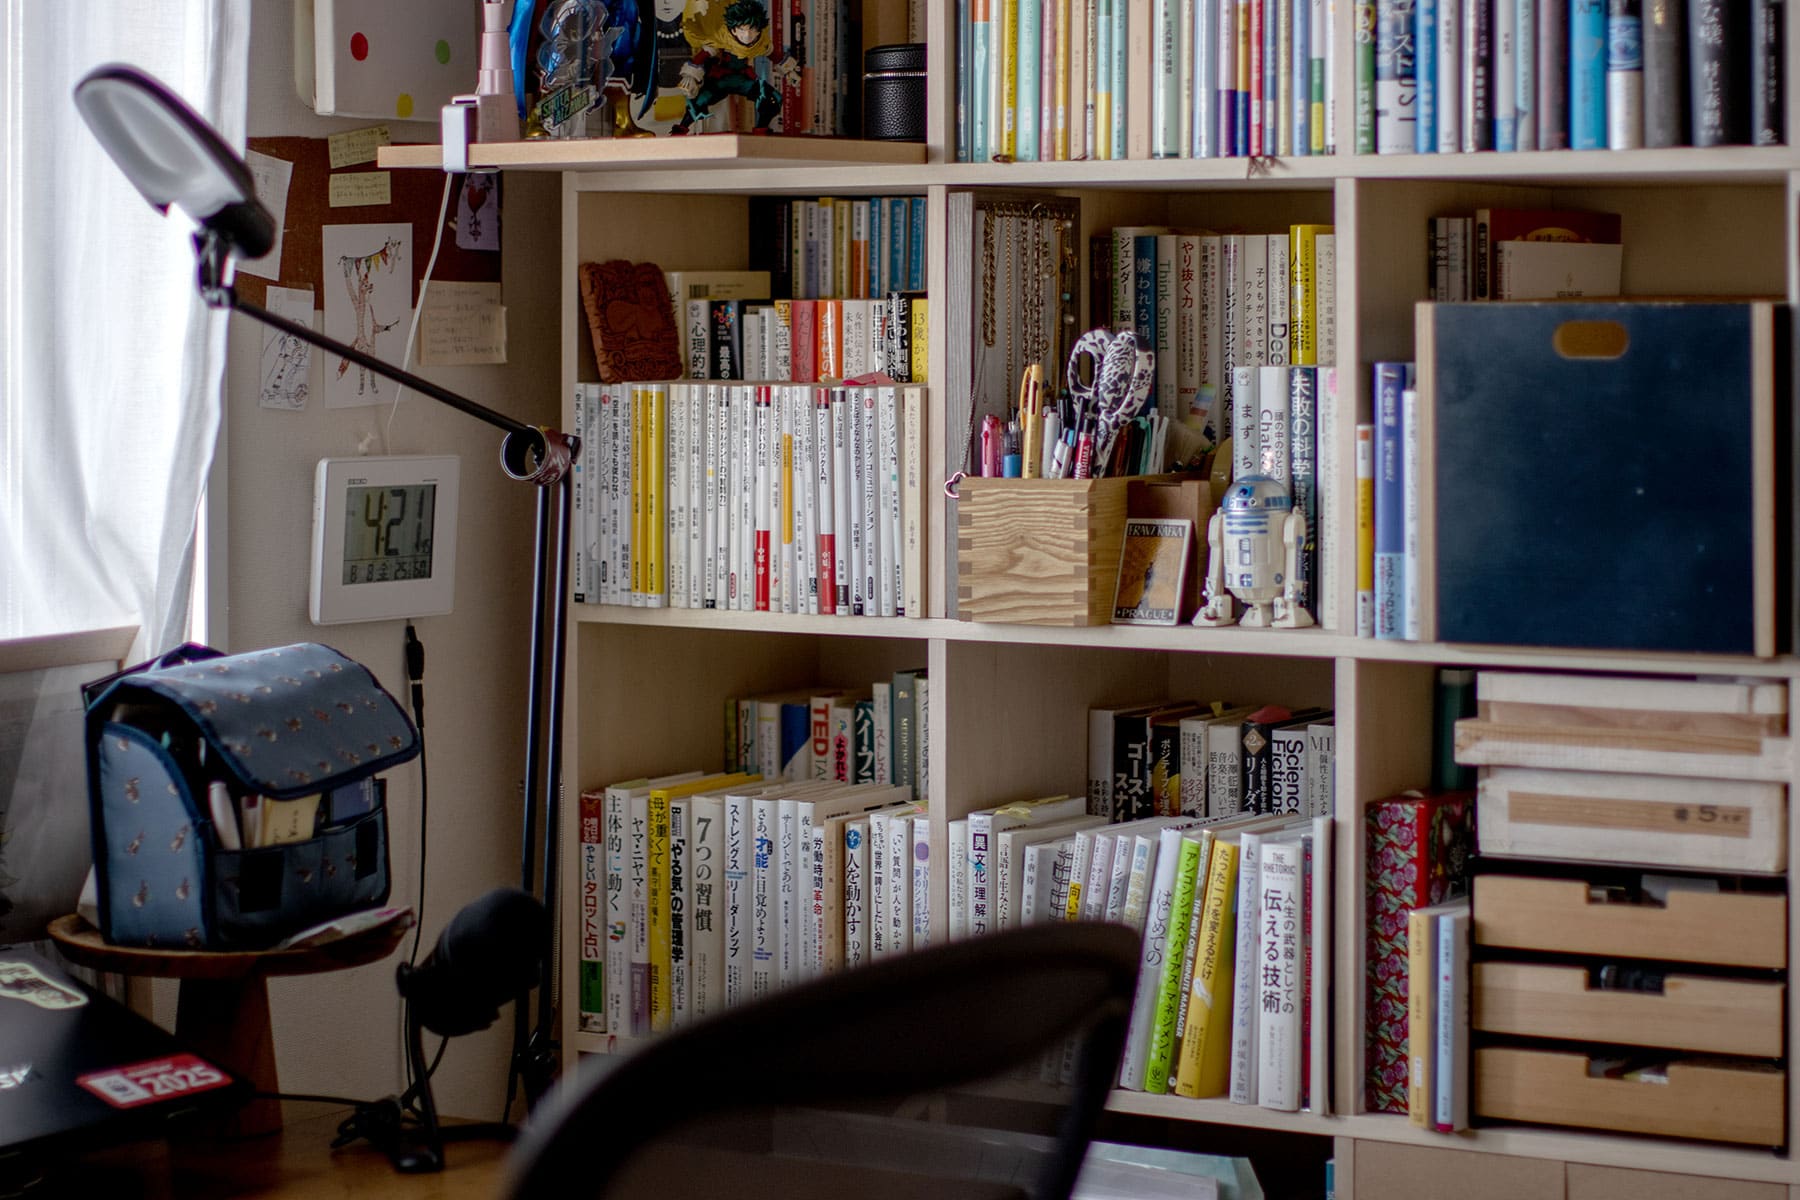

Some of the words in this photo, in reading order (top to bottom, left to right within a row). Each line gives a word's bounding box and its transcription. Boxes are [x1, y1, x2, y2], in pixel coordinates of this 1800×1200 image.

[1119, 237, 1131, 322] ジェンダーと脳
[1159, 260, 1171, 302] Think
[1181, 241, 1195, 309] やり抜く力
[1291, 251, 1304, 351] 人に技術
[854, 311, 863, 374] 女性に伝えたい
[1159, 307, 1171, 352] Smart
[1224, 287, 1236, 412] レジリエンスの鍛え方
[1256, 267, 1264, 364] 子どもができて考
[1271, 323, 1287, 365] Dee
[818, 412, 827, 485] フィードバック入門
[888, 394, 897, 465] アサーション入門
[1291, 372, 1310, 479] 失敗の科学
[866, 415, 874, 531] アサーティブ・コミュニケーション
[365, 489, 424, 555] 4:21
[1128, 524, 1156, 537] FRANZ
[1156, 524, 1184, 537] KAFKA
[1121, 608, 1168, 619] PRAGUE
[813, 703, 829, 756] TED
[815, 760, 827, 781] TA
[1127, 741, 1146, 815] ゴースト
[1209, 752, 1218, 794] 話をする
[1227, 752, 1238, 814] 小澤征爾さ
[1271, 740, 1286, 815] Fictions
[608, 795, 622, 911] 主体的に動く
[632, 817, 644, 887] ヤマ・ニヤマ
[654, 797, 667, 865] 母が重くて
[730, 804, 740, 870] ストレングス
[782, 814, 793, 893] サーバントであれ
[802, 815, 811, 852] 夜と霧
[1272, 853, 1285, 863] THE
[585, 845, 599, 958] やさしいタロット占い
[671, 839, 685, 962] 「やる気」の管理学
[696, 817, 713, 932] 7つの習慣
[755, 808, 769, 946] さあ、才能に目覚めよう
[813, 837, 823, 915] 労働時間革命
[846, 853, 861, 935] 人を動かす
[874, 851, 883, 952] 世界一誇りにしたい会社
[892, 832, 904, 950] 「いい質問」が人を動かす
[972, 832, 988, 937] 異文化理解力
[1263, 863, 1296, 875] RHETORIC
[730, 880, 740, 958] リーダーシップ
[1146, 889, 1173, 968] はじめての
[1167, 851, 1201, 985] アンコンシャス・バイアス
[1189, 916, 1199, 937] NEW
[1192, 900, 1201, 916] THE
[1201, 848, 1231, 979] たった一つを変えるだけ
[1182, 956, 1194, 994] MINUTE
[1187, 938, 1196, 953] ONE
[1239, 877, 1254, 1027] マイクロスパイ・アンサンブル
[1263, 889, 1281, 1014] 伝える技術
[1283, 891, 1296, 1014] 人生の武器としての
[1159, 992, 1177, 1061] マネジメント
[1176, 995, 1189, 1038] MANAGER
[139, 1063, 222, 1096] 2025
